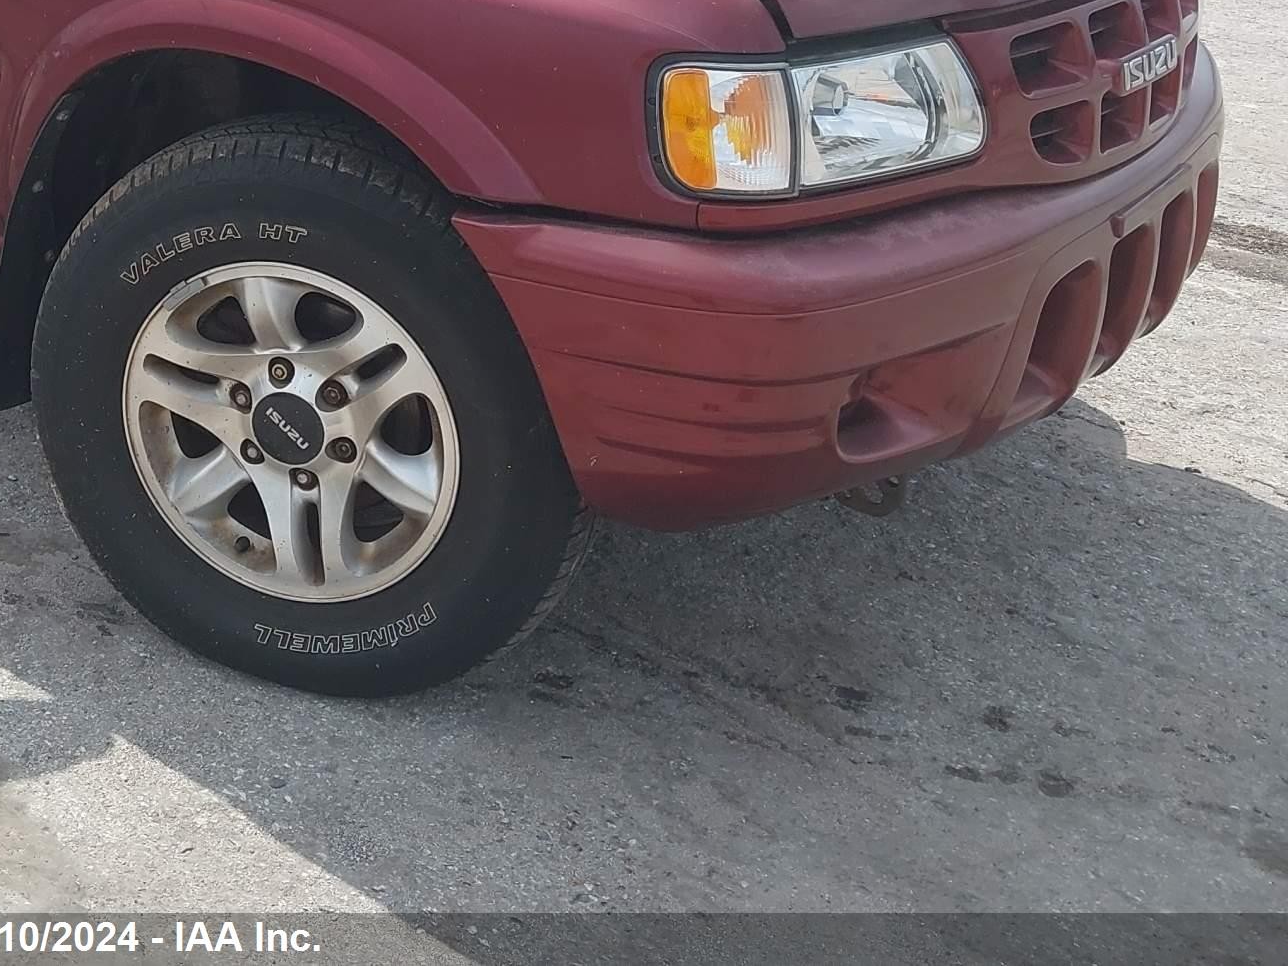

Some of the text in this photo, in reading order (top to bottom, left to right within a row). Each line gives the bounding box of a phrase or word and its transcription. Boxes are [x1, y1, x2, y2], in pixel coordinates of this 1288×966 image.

[1123, 39, 1178, 91] ISUZU
[120, 223, 308, 285] VALERA HT
[265, 407, 310, 450] ISUZU
